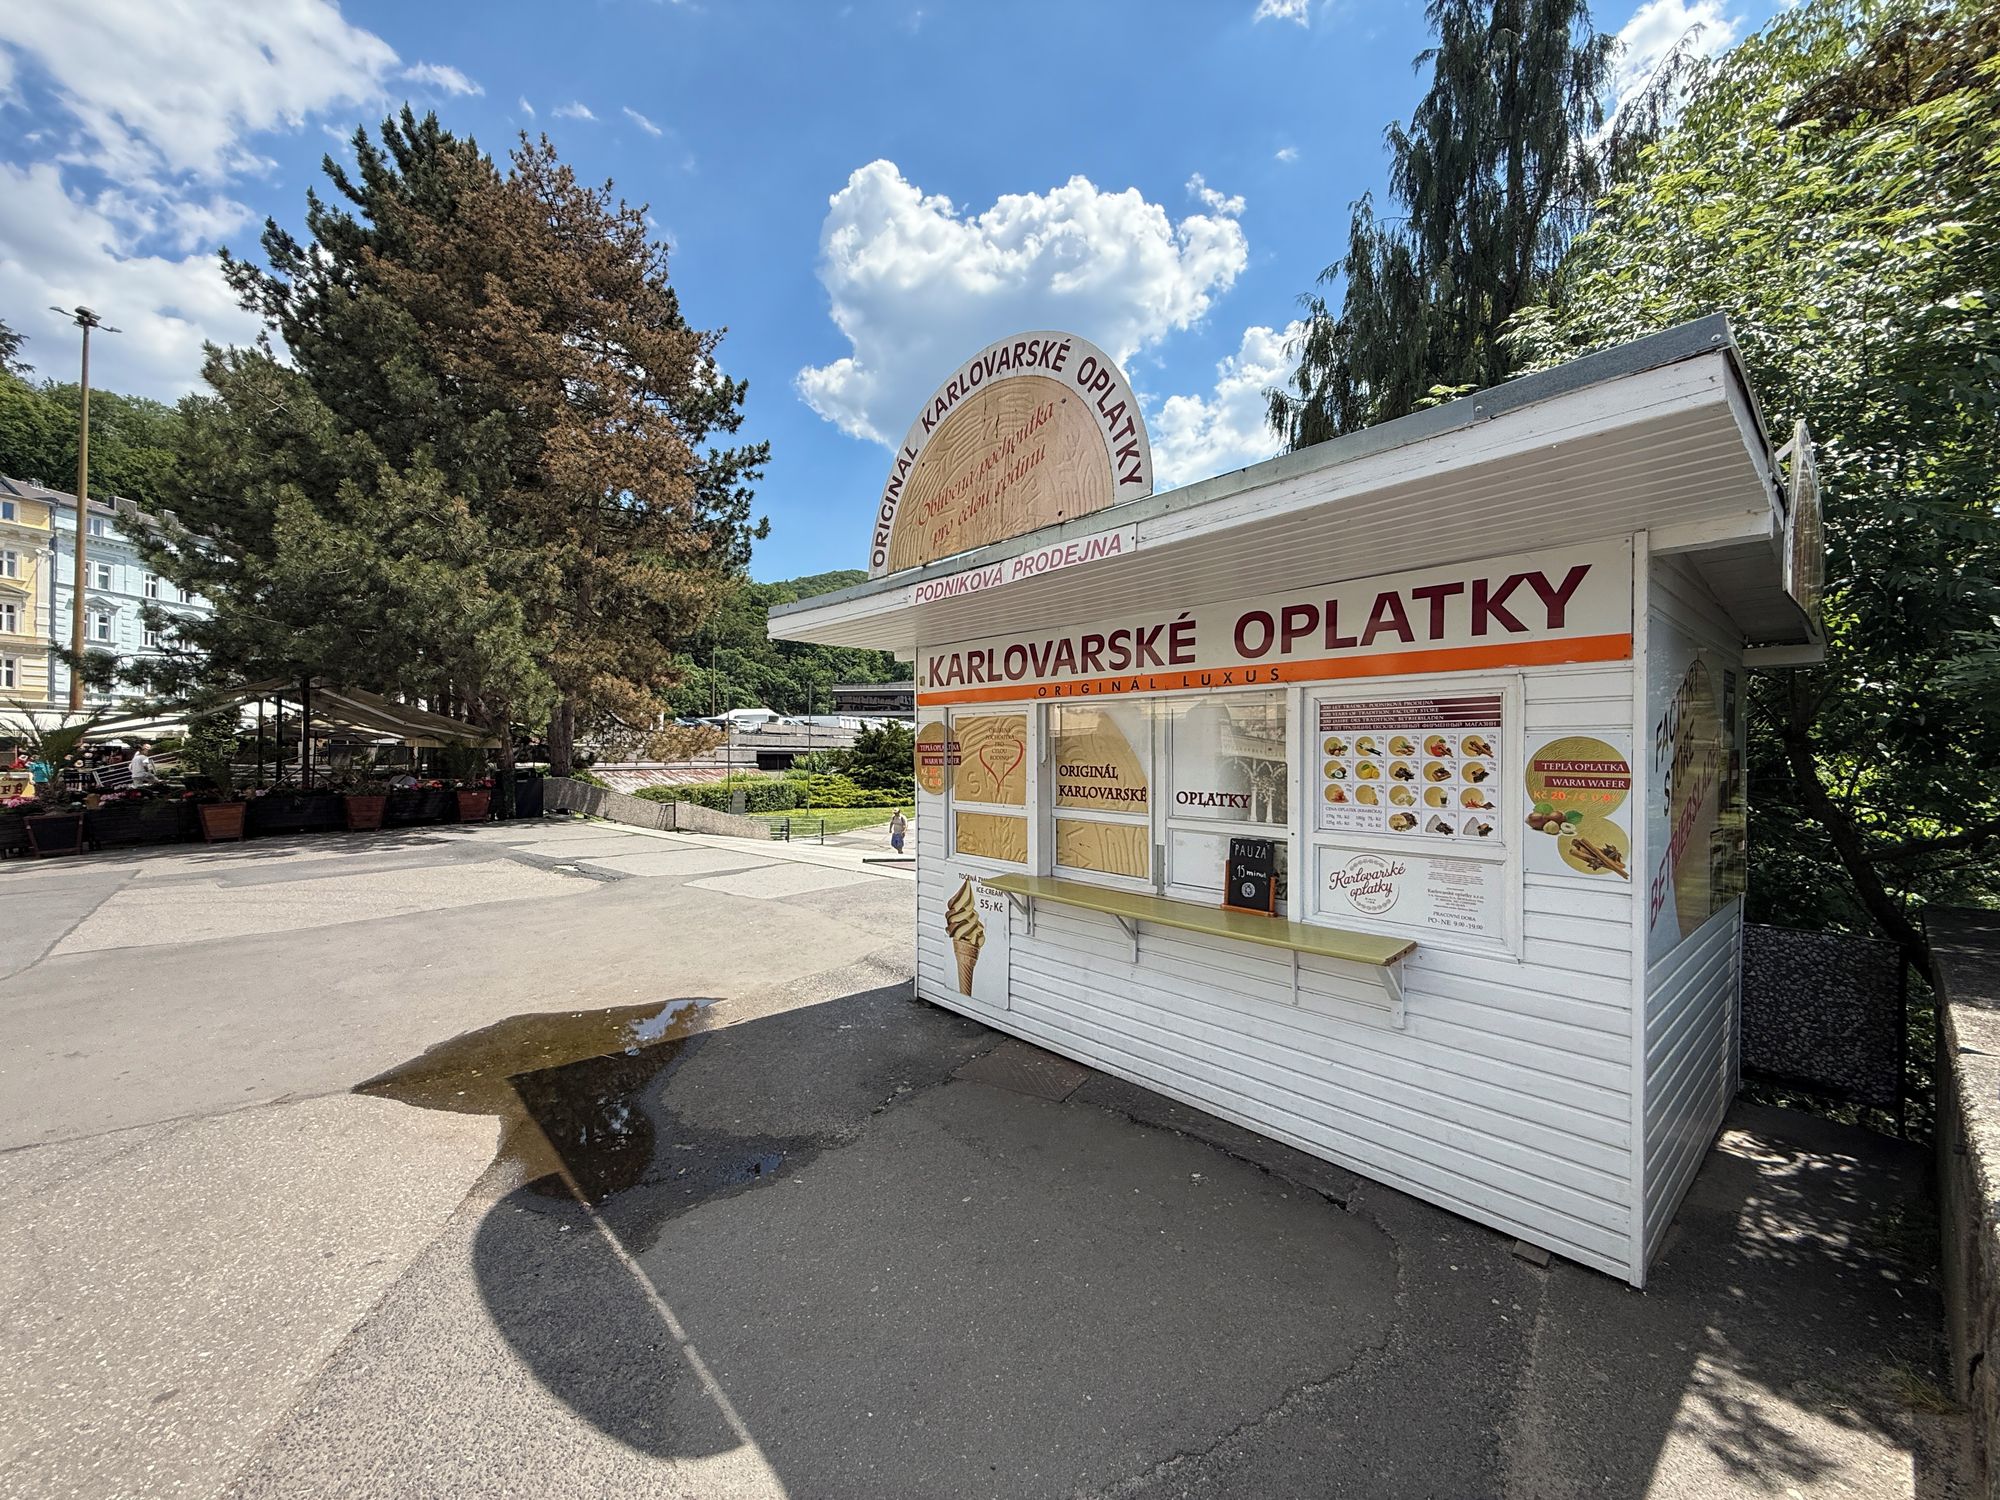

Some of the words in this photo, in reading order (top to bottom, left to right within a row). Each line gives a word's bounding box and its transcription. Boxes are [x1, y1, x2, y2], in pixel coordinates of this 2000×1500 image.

[872, 446, 918, 568] ORIGINÁL
[921, 338, 1072, 434] KARLOVARSKÉ
[1077, 356, 1143, 486] OPLATKY
[933, 519, 954, 550] pro
[914, 561, 1003, 604] PODNIKOVÁ
[1012, 533, 1122, 580] PRODEJNA
[928, 612, 1196, 688] KARLOVARSKÉ
[1233, 563, 1592, 660] OPLATKY
[1038, 674, 1156, 697] ORIGINÁL
[1183, 667, 1280, 687] LUXUS
[1059, 763, 1119, 780] ORIGINÁL
[1542, 761, 1573, 771] TEPLÁ
[1574, 762, 1625, 772] OPLATKA
[1551, 778, 1585, 788] WARM
[1587, 779, 1625, 788] WAFER
[1058, 785, 1147, 803] KARLOVARSKÉ
[1176, 791, 1252, 809] OPLATKY
[1234, 844, 1267, 859] PAUZA
[1237, 864, 1245, 878] 15
[1329, 861, 1406, 890] Karlovarské
[976, 886, 1004, 897] ICE-CREAM
[1350, 879, 1393, 901] oplatky
